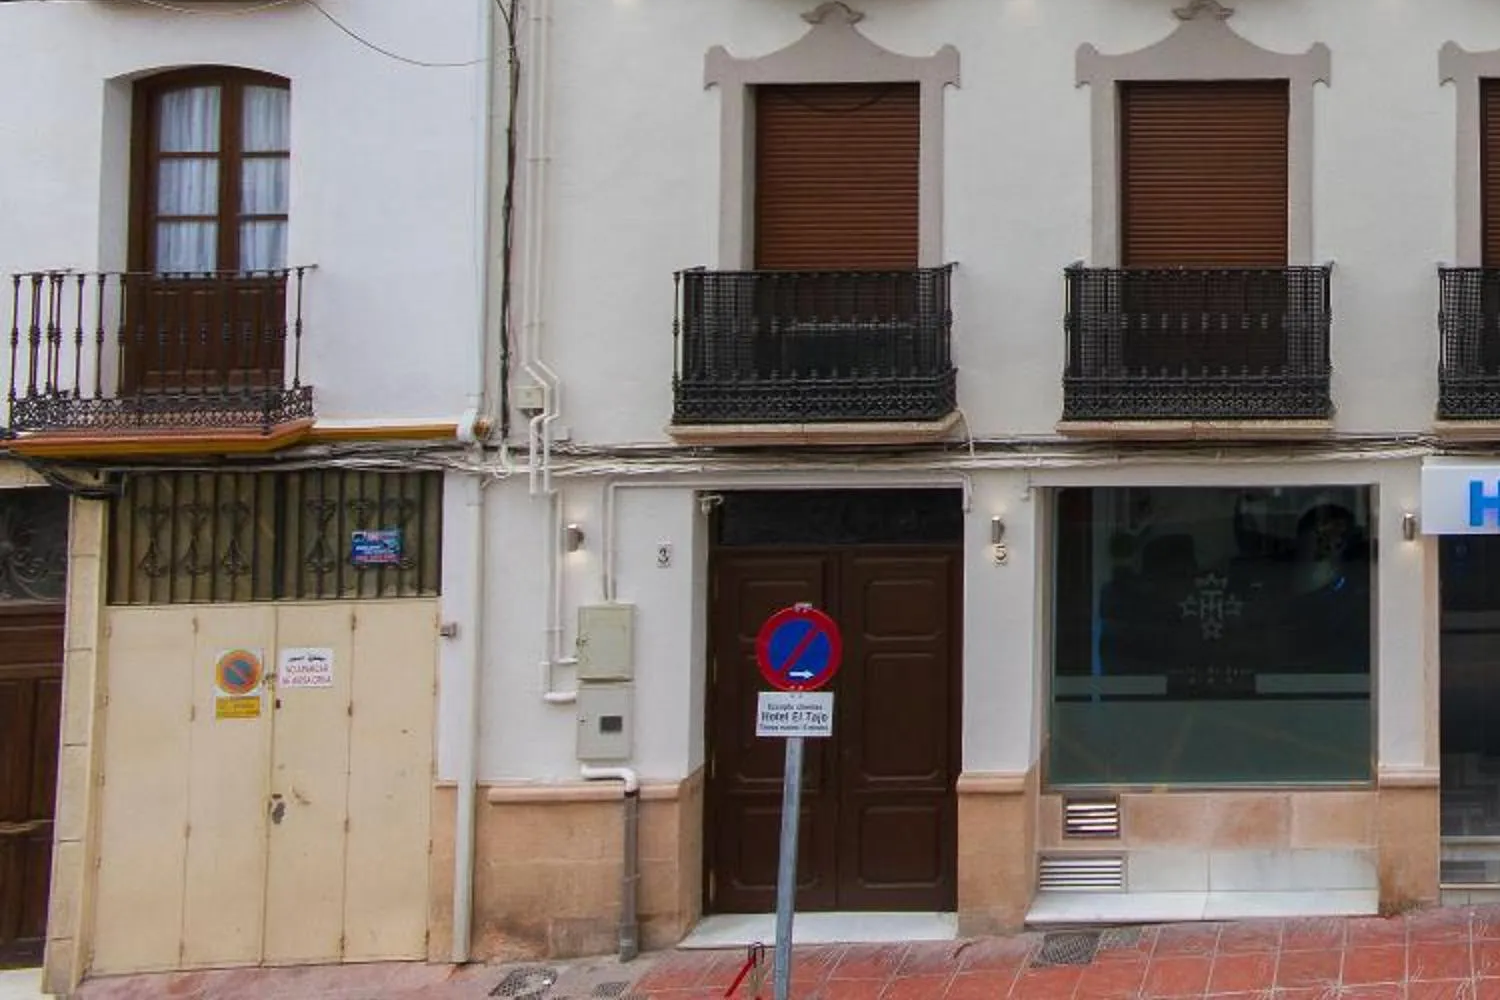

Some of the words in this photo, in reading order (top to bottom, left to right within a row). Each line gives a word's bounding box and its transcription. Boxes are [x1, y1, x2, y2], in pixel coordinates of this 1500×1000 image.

[762, 711, 788, 721] Hotel
[791, 711, 803, 721] El
[806, 711, 829, 724] Tajo
